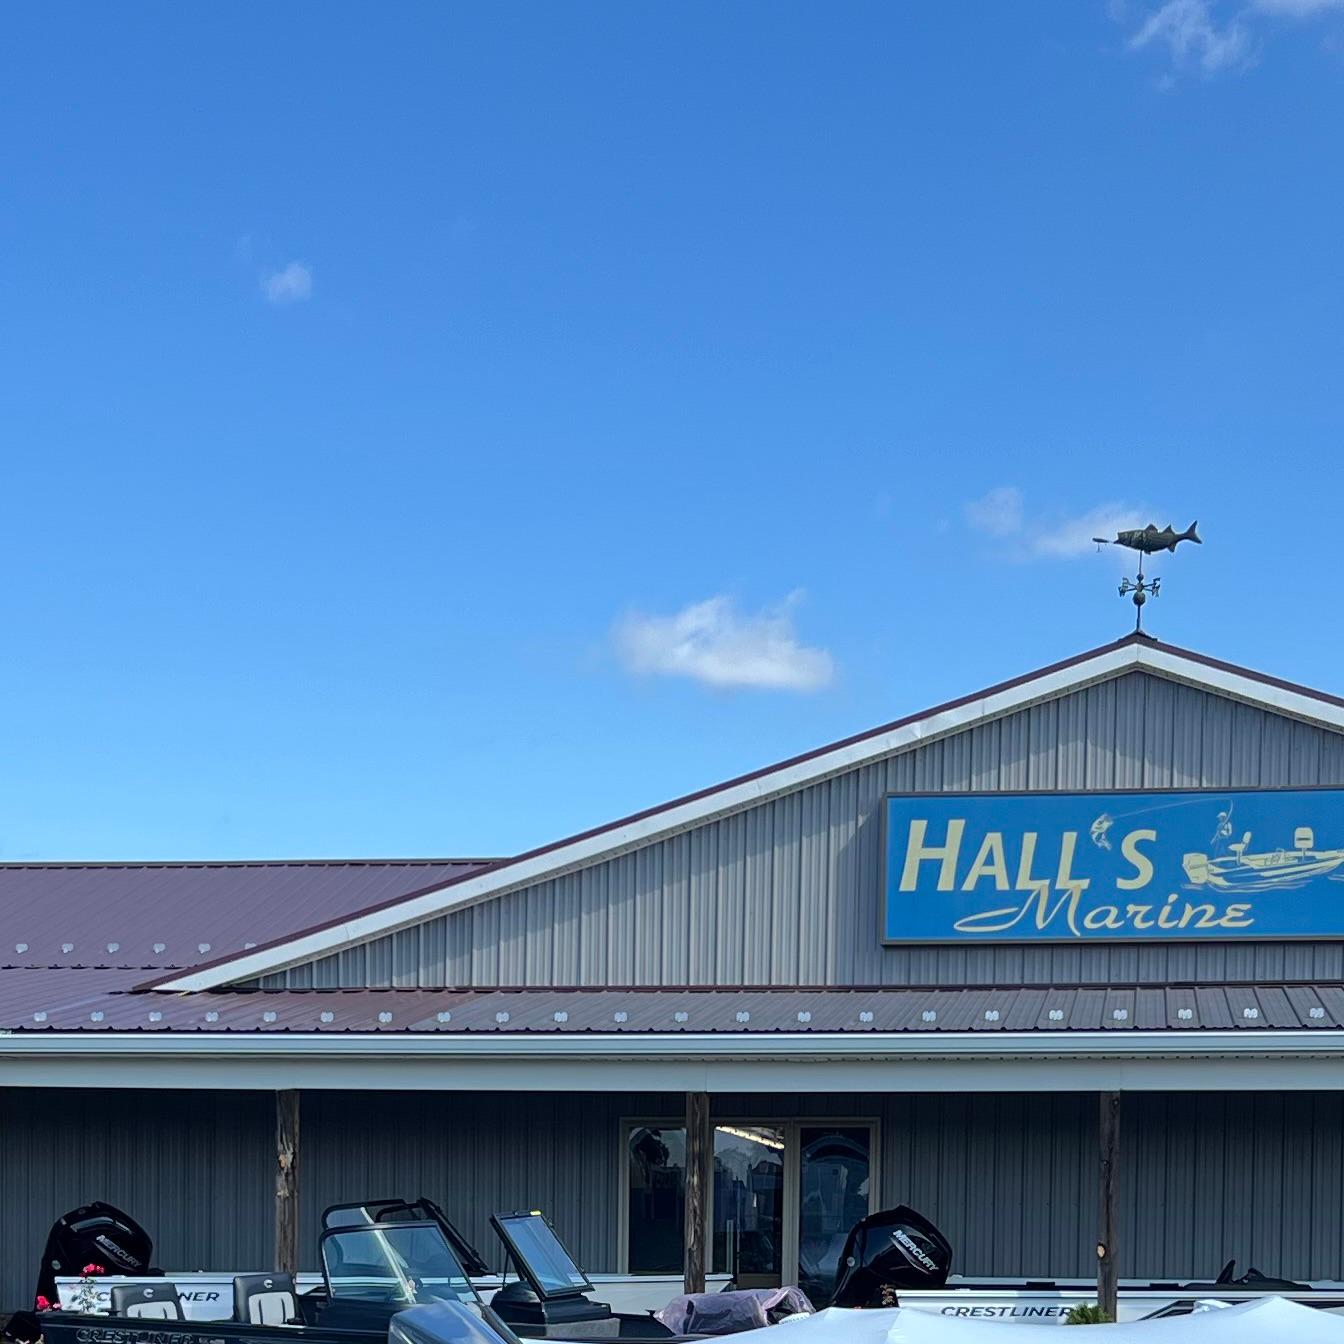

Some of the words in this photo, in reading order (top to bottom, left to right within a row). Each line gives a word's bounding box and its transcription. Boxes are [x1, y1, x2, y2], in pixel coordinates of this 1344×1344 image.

[899, 819, 1157, 892] HALL'S
[953, 883, 1255, 937] Marine
[95, 1234, 143, 1268] MERCURY
[892, 1229, 940, 1271] MERCURY
